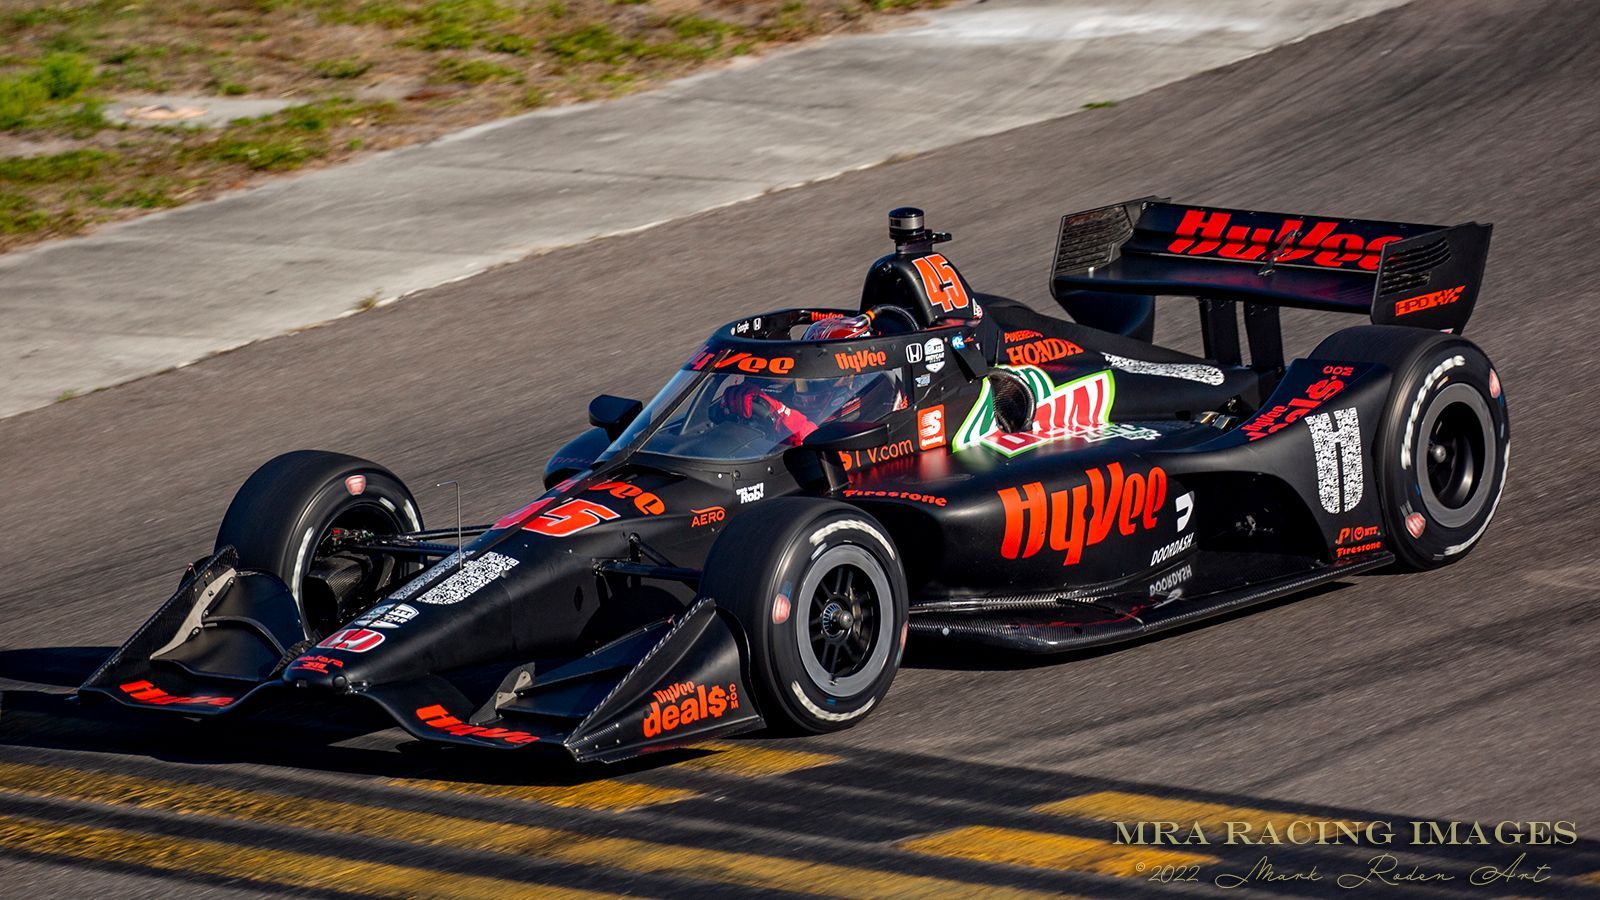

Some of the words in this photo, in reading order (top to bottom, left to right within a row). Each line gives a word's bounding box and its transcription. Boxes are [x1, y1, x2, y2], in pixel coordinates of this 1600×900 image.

[1167, 210, 1404, 271] HyVee
[912, 253, 969, 312] 45
[1396, 296, 1430, 314] HPD
[691, 347, 795, 374] yVee
[834, 350, 887, 372] HyVee
[1006, 338, 1085, 365] HONDA
[843, 488, 948, 507] Firestone
[691, 509, 726, 528] AERO
[997, 462, 1167, 566] HyVee
[1150, 532, 1194, 567] DOORDASH
[1336, 541, 1382, 558] Firestone
[653, 681, 695, 703] HyVee
